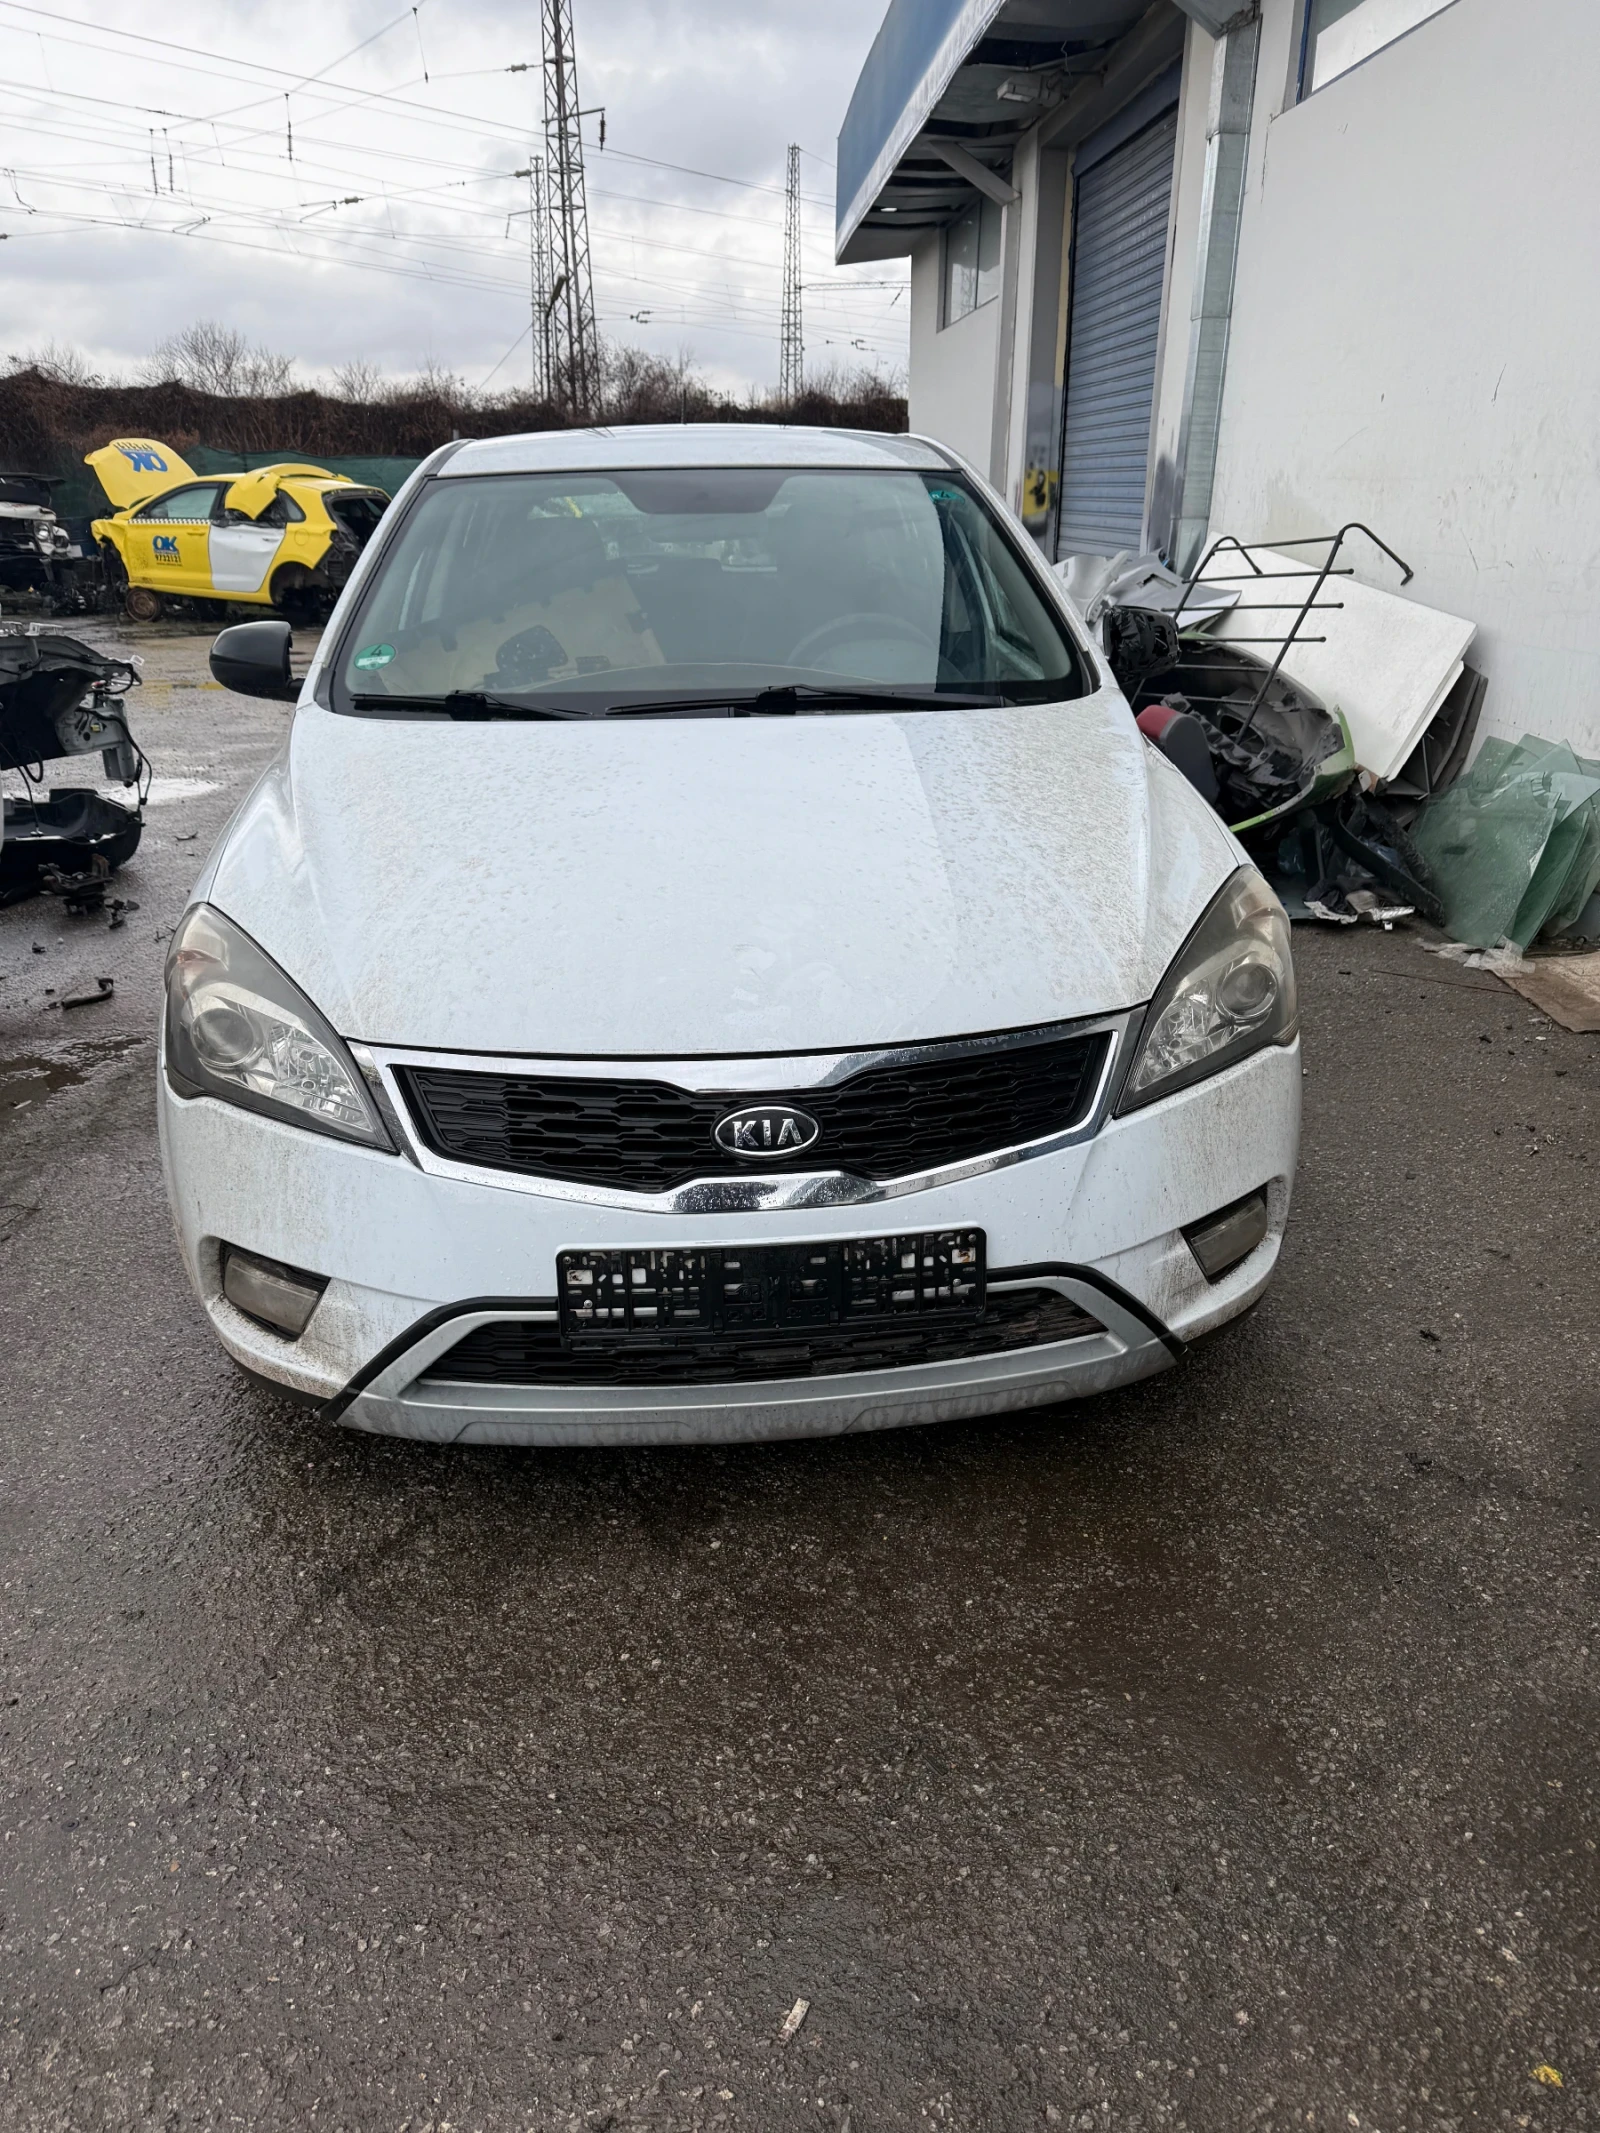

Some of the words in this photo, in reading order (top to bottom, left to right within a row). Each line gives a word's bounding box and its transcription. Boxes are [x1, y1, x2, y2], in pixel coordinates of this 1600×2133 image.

[120, 451, 168, 472] OK
[152, 535, 178, 552] OK
[371, 645, 382, 656] 4
[732, 1118, 803, 1147] KIA
